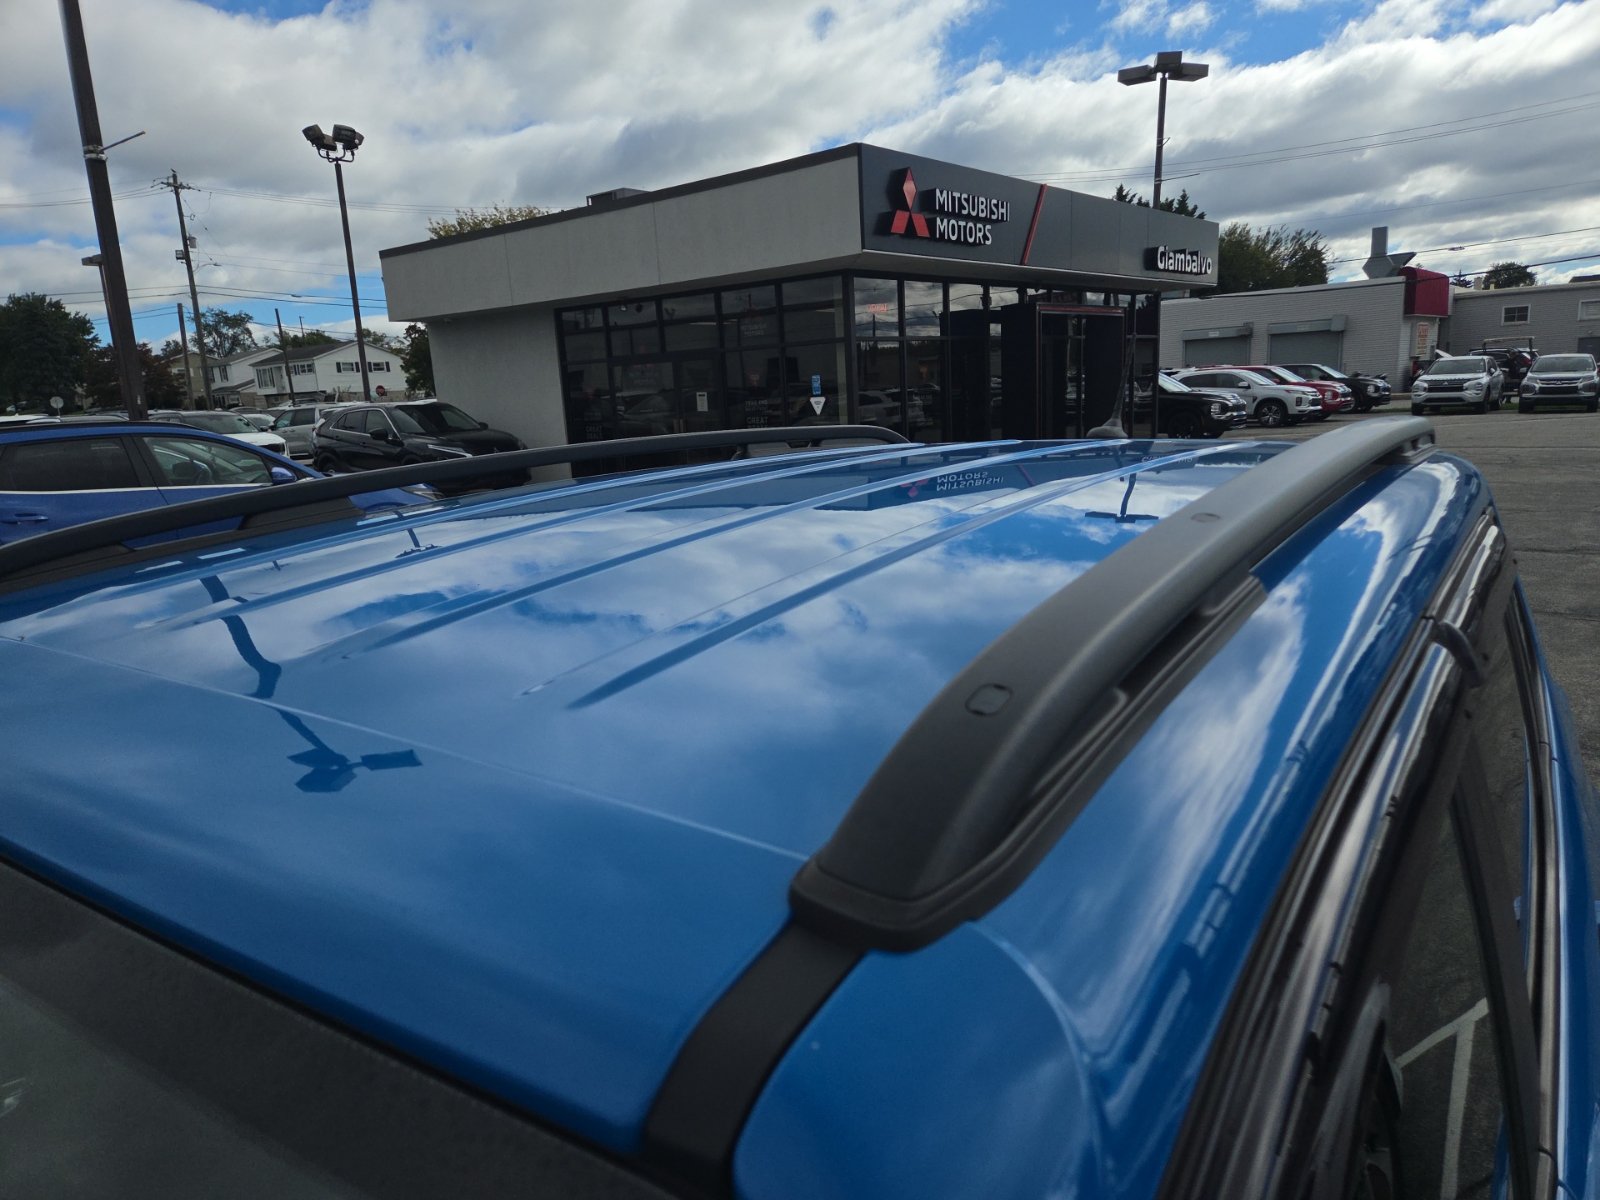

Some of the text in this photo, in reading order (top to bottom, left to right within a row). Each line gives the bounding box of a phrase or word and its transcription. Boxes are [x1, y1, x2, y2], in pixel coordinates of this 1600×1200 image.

[935, 188, 1010, 222] MITSUBISHI
[936, 216, 992, 245] MOTORS
[1157, 245, 1213, 275] Giambalvo
